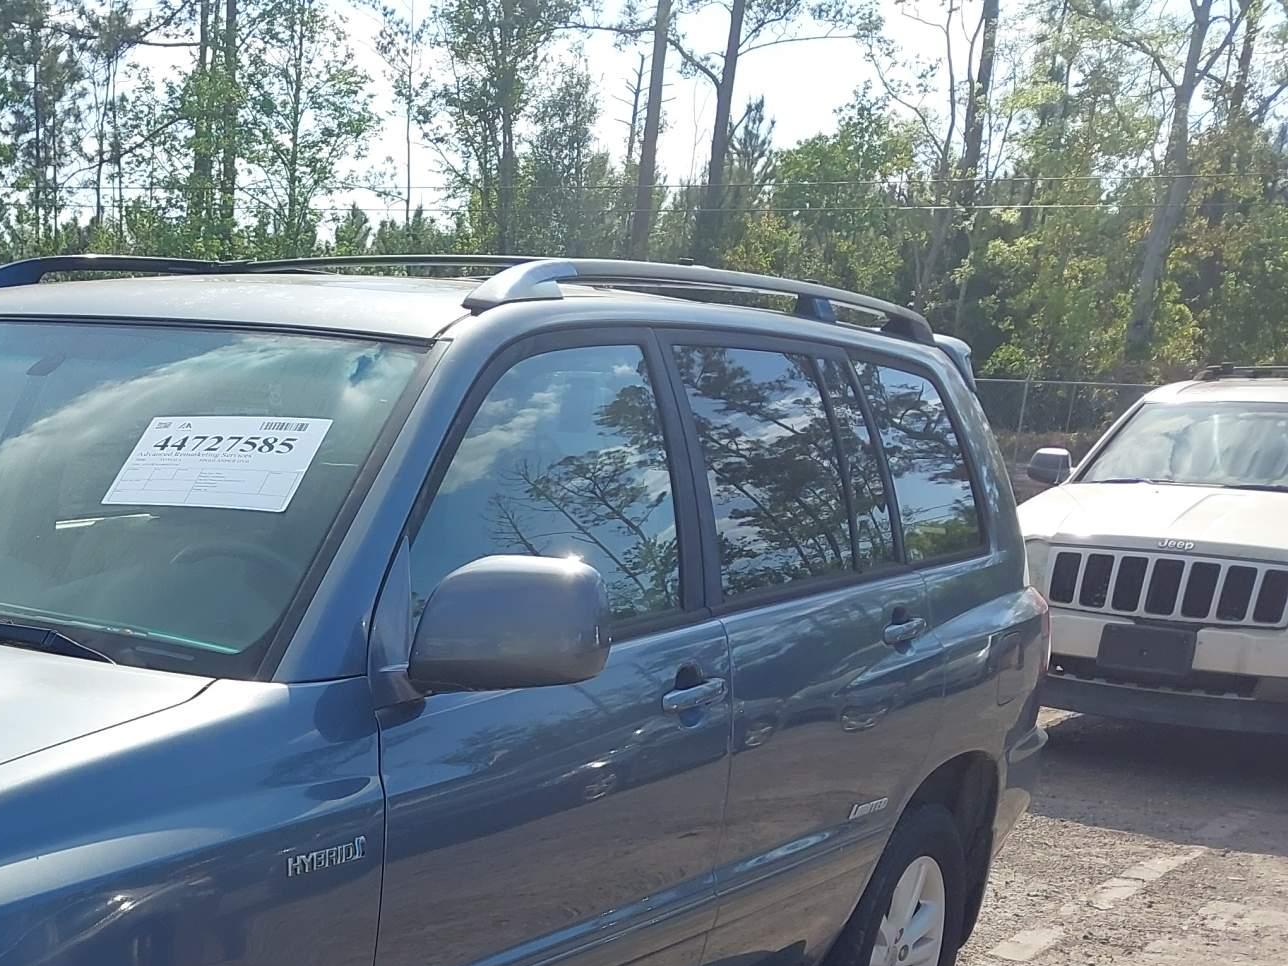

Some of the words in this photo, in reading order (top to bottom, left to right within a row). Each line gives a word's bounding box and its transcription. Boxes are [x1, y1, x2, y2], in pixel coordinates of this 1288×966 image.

[153, 435, 298, 454] 44727585
[1158, 538, 1194, 550] Jeep
[288, 842, 354, 877] HYBRID
